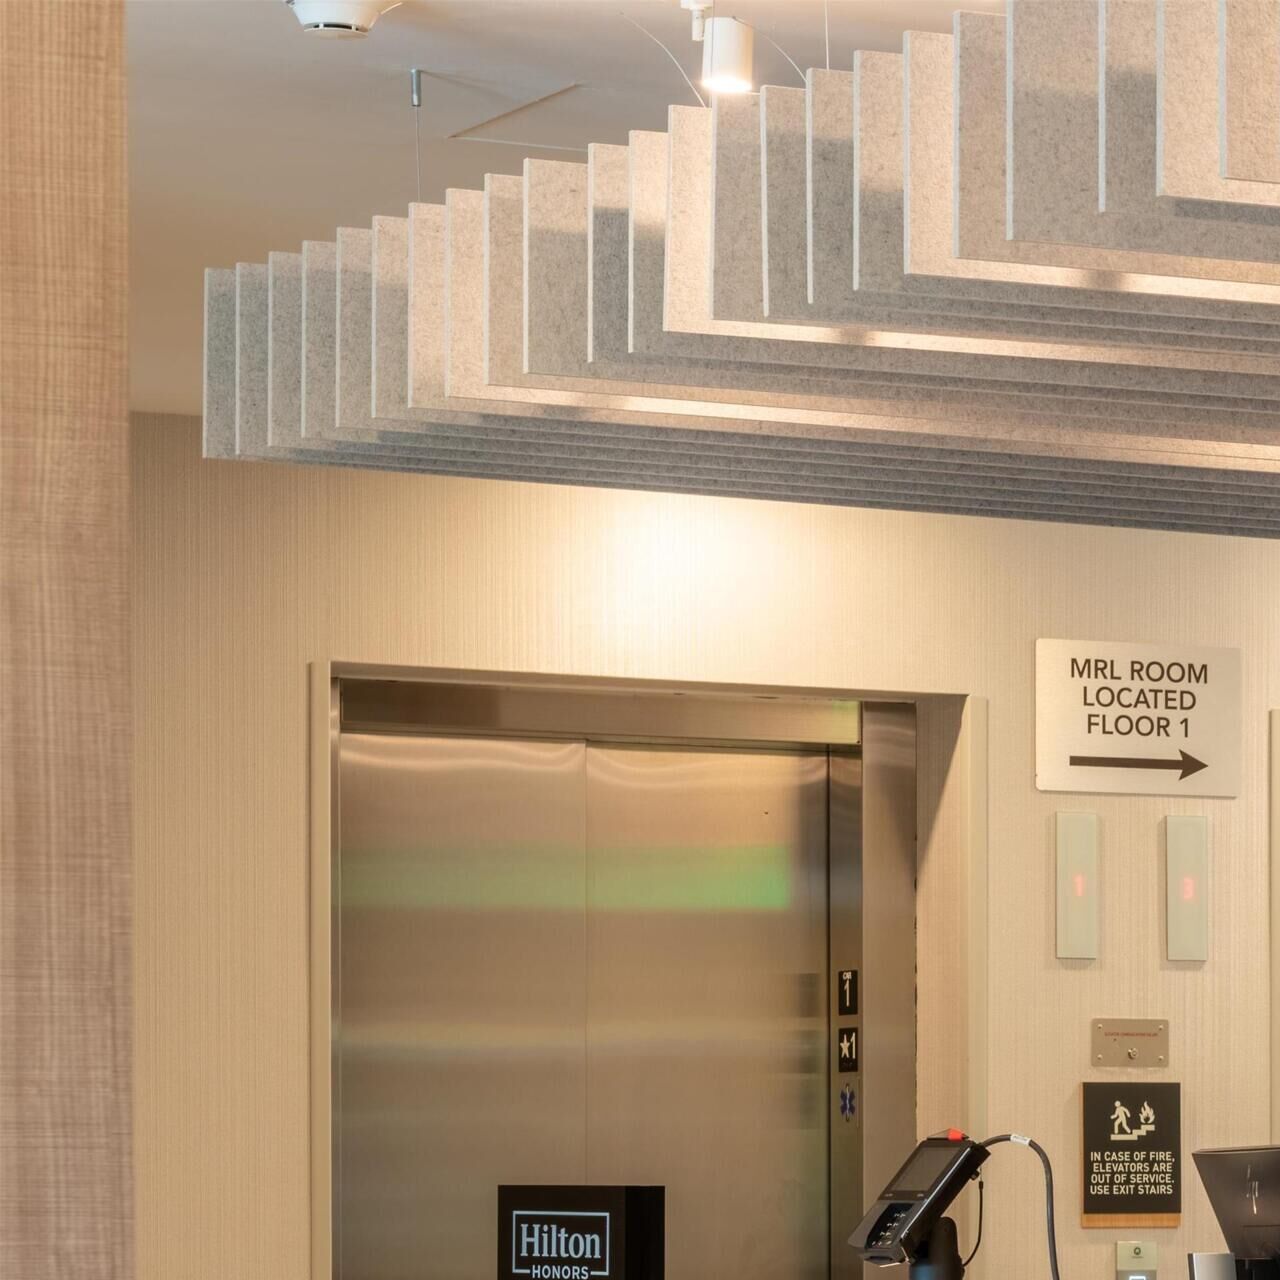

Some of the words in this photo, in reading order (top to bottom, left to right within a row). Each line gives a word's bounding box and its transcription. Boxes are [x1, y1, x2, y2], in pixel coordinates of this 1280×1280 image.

[1070, 658, 1122, 681] MRL
[1130, 660, 1208, 684] ROOM
[1083, 686, 1196, 711] LOCATED
[1087, 714, 1170, 737] FLOOR
[1180, 718, 1189, 738] 1
[1090, 1151, 1101, 1161] IN
[1104, 1151, 1131, 1161] CASE
[1133, 1151, 1147, 1161] OF
[1149, 1151, 1175, 1163] FIRE,
[1093, 1162, 1150, 1172] ELEVATORS
[1152, 1162, 1173, 1172] ARE
[1091, 1173, 1111, 1184] OUT
[1114, 1173, 1127, 1184] OF
[1130, 1173, 1175, 1184] SERVICE.
[1090, 1184, 1110, 1195] USE
[1113, 1184, 1135, 1195] EXIT
[1138, 1184, 1173, 1195] STAIRS
[520, 1223, 602, 1259] Hilton
[531, 1264, 589, 1280] HONORS
